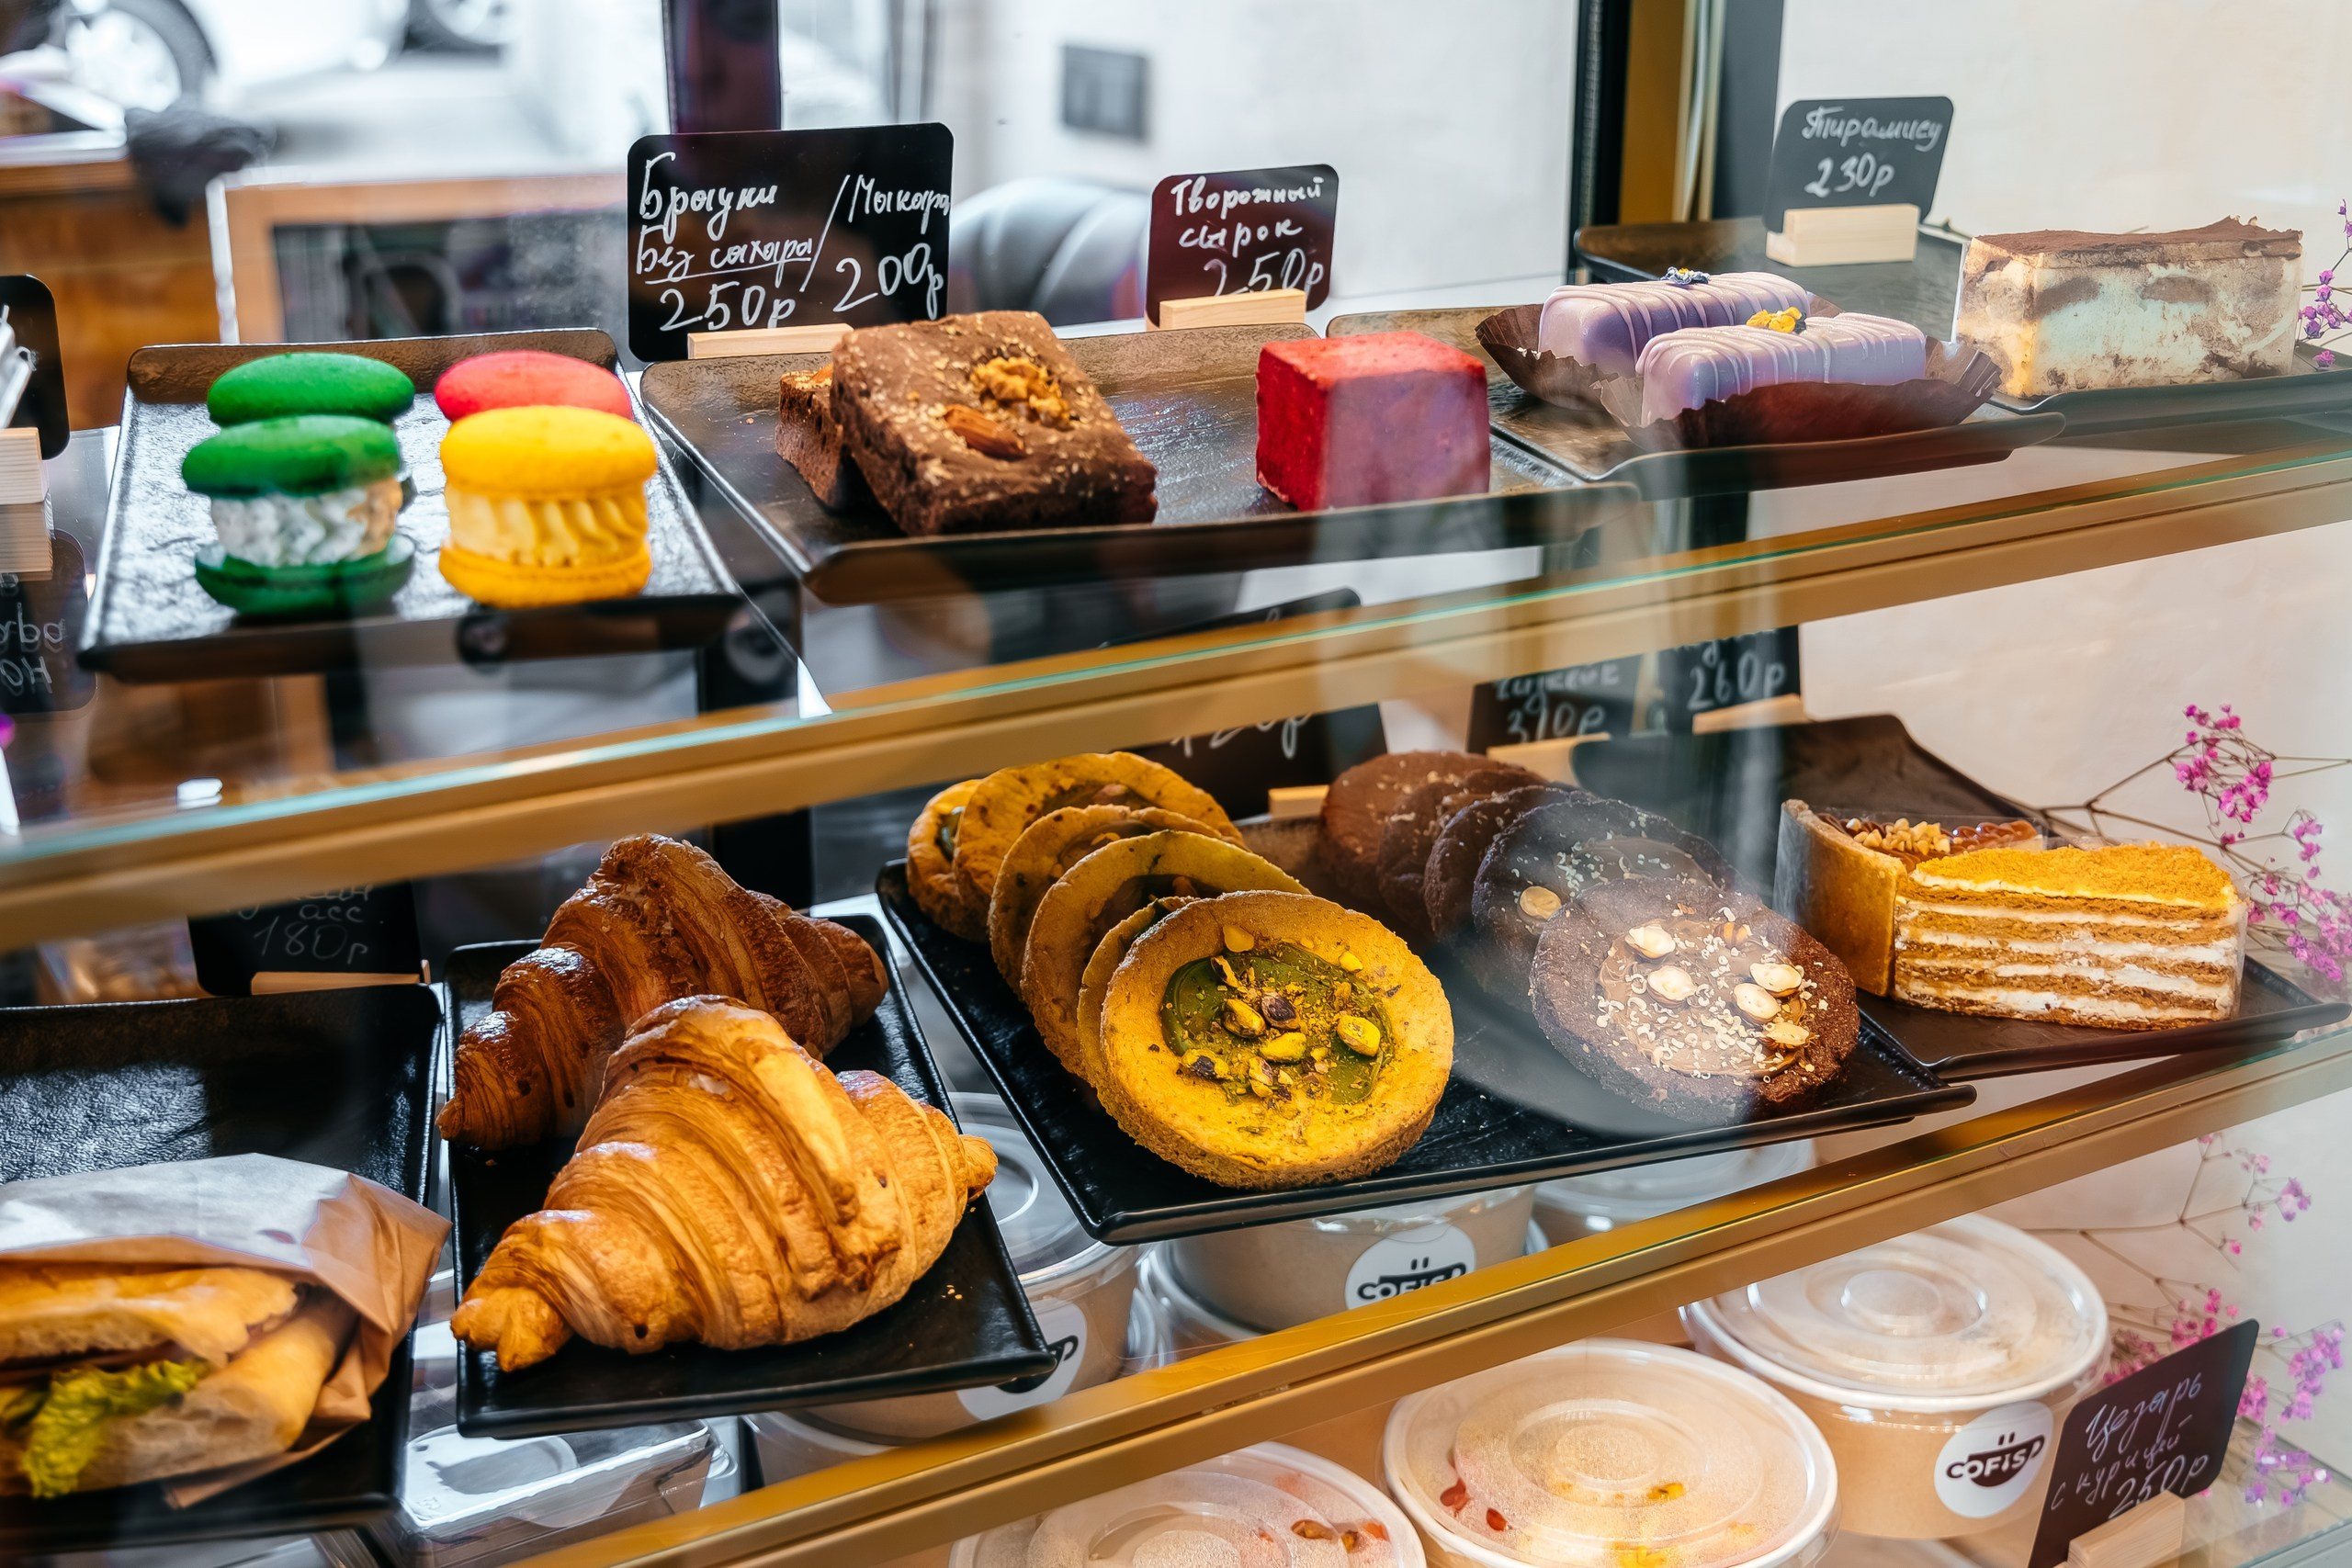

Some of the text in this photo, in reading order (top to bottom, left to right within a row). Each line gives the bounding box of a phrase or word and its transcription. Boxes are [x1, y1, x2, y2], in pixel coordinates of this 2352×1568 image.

[1802, 106, 1943, 152] Тирамису
[639, 152, 779, 244] Брауни
[1170, 175, 1325, 220] Творожный
[1804, 152, 1895, 197] 230р
[710, 237, 813, 288] сахара
[1179, 219, 1304, 258] сырок
[833, 243, 944, 321] 200р
[1204, 248, 1325, 298] 250р
[660, 280, 797, 331] 250р
[1686, 649, 1788, 711] 260р
[253, 915, 368, 964] 180р
[2086, 1372, 2202, 1462] Цезарь
[2108, 1454, 2210, 1519] 250р
